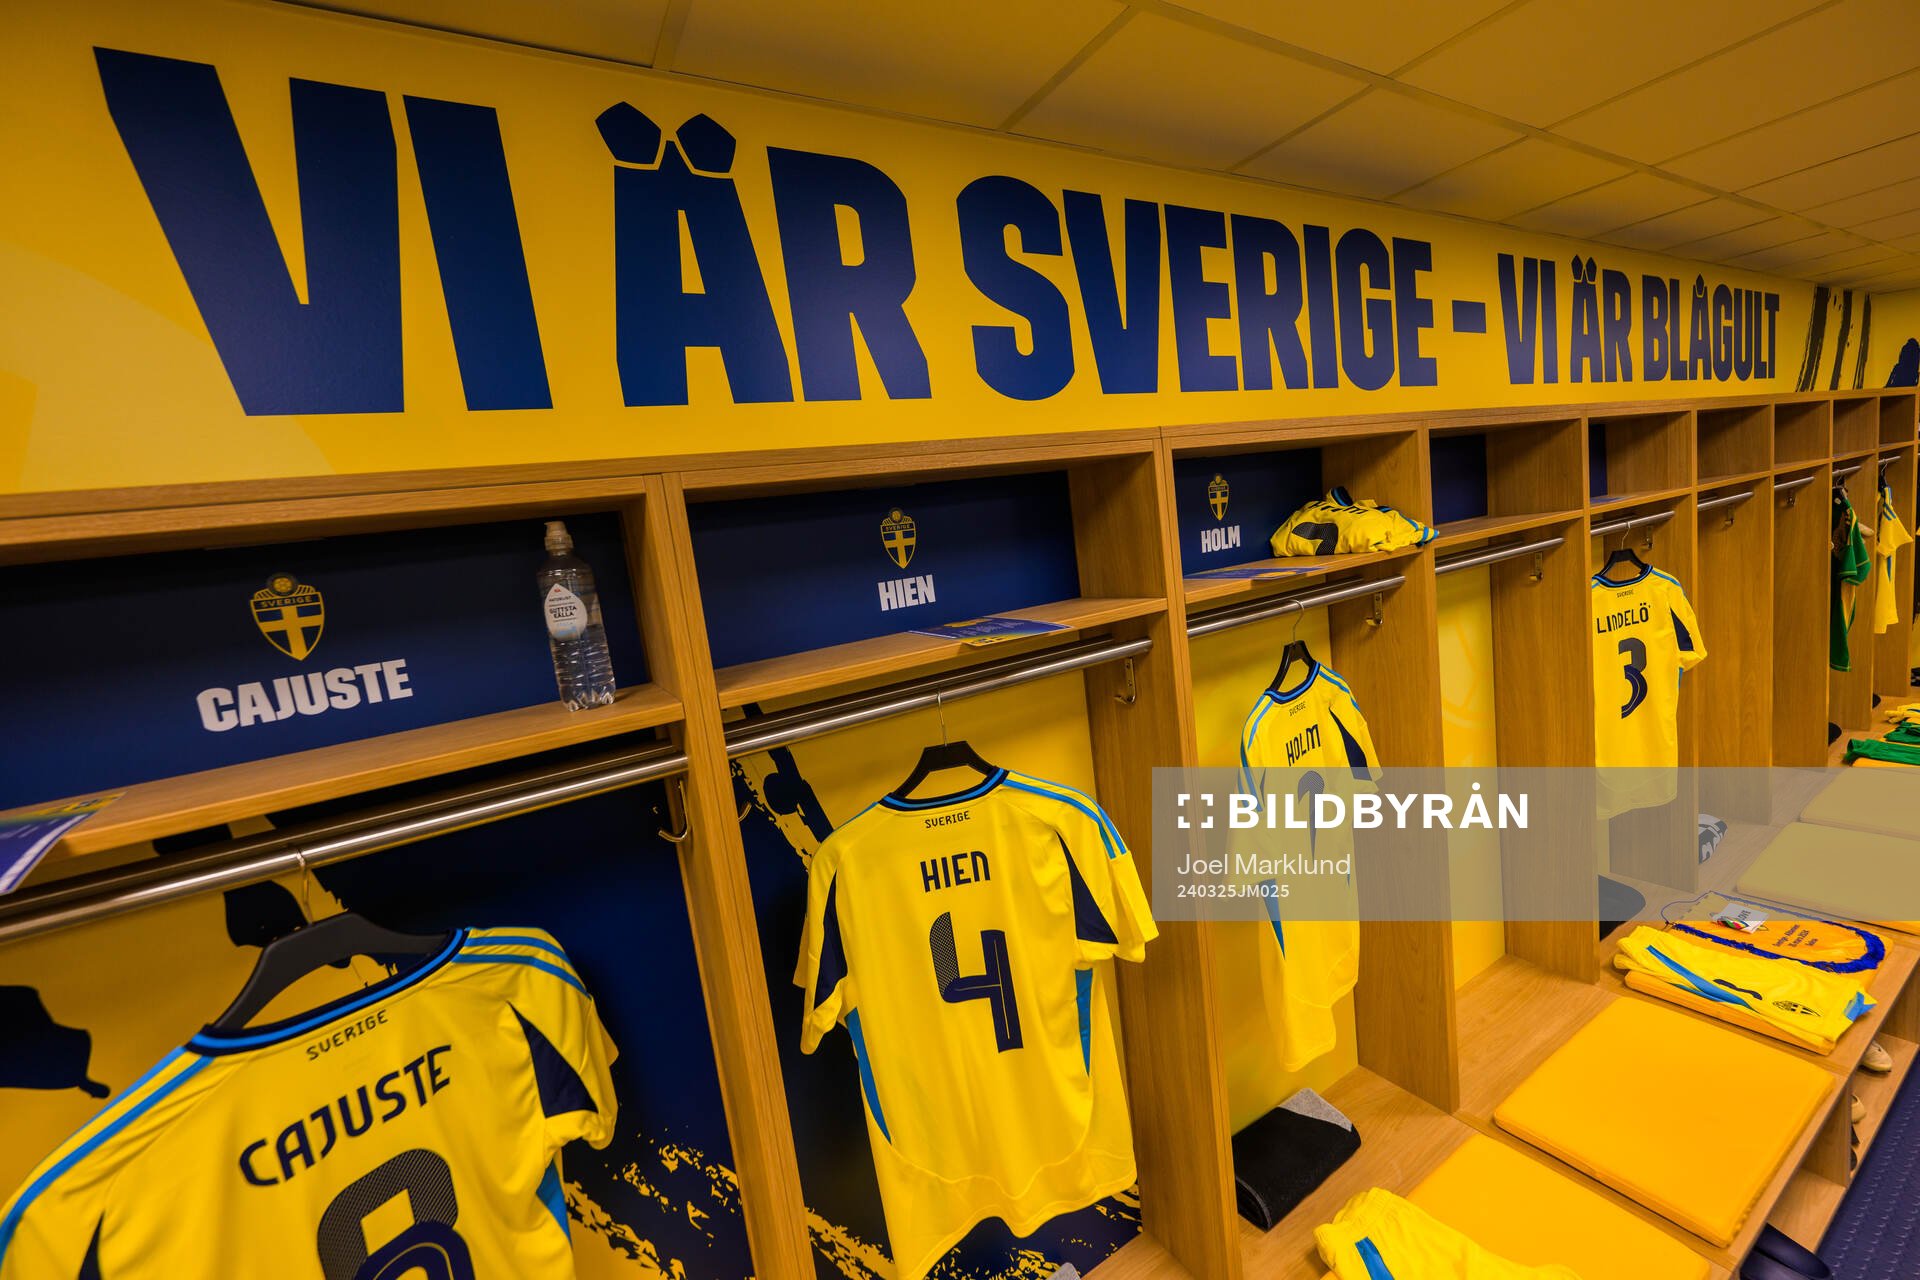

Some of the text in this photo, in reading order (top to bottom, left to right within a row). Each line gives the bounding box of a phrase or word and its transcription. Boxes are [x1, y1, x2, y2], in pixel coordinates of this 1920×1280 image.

[93, 46, 554, 416] VI
[595, 101, 932, 407] ÄR
[956, 175, 1438, 401] SVERIGE
[1497, 253, 1559, 384] VI
[1570, 254, 1633, 383] ÄR
[1642, 273, 1779, 382] BLÅGULT
[1200, 525, 1241, 553] HOLM
[260, 595, 313, 608] SVERIGE
[877, 574, 937, 612] HIEN
[196, 658, 413, 732] CAJUSTE
[1618, 637, 1648, 719] 3
[1286, 723, 1321, 767] HOLM
[924, 810, 971, 829] SVERIGE
[920, 850, 991, 893] HIEN
[929, 911, 1024, 1054] 4
[305, 1009, 389, 1062] SVERIGE
[238, 1044, 452, 1187] CAJUSTE
